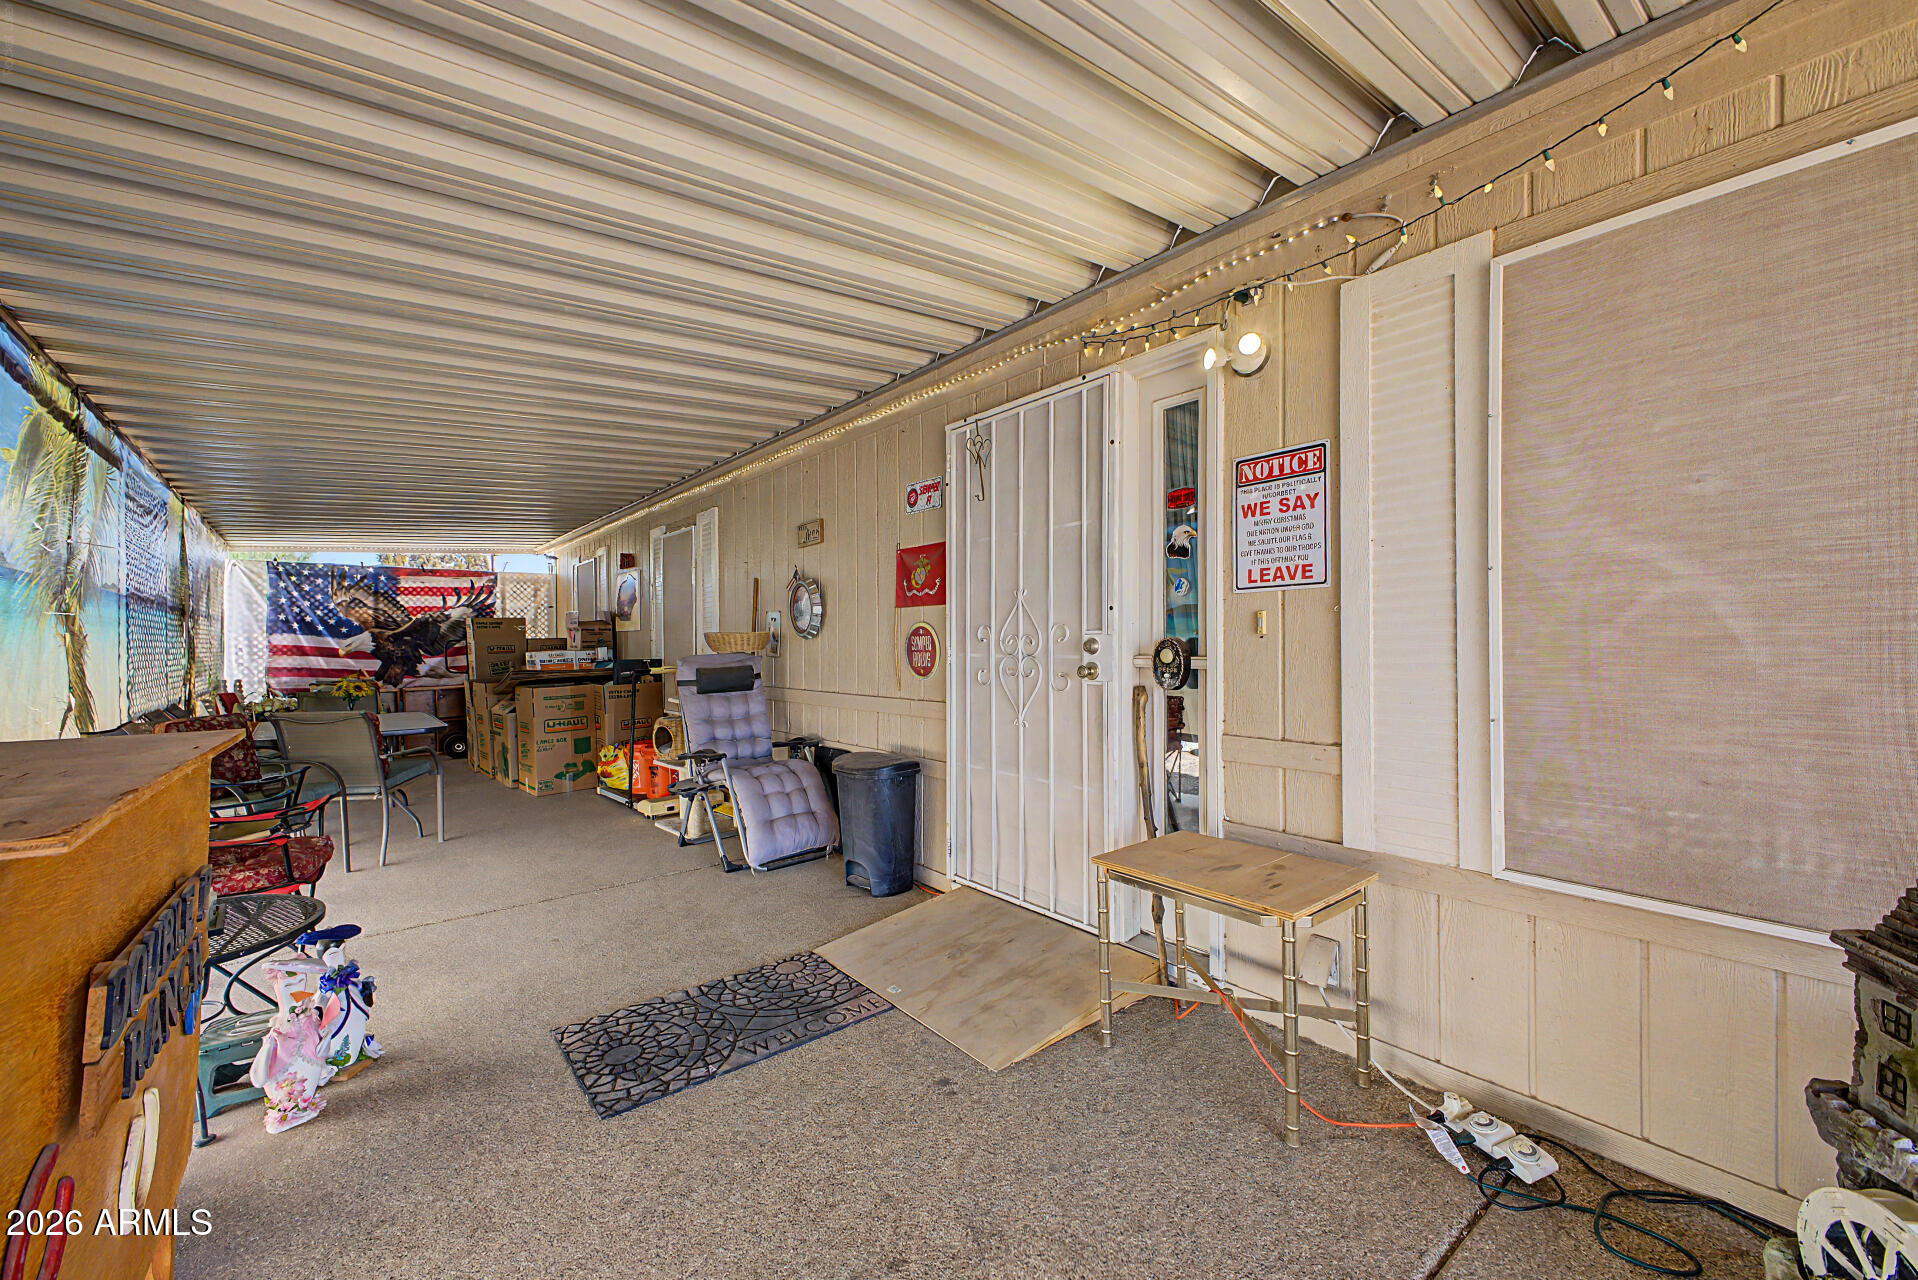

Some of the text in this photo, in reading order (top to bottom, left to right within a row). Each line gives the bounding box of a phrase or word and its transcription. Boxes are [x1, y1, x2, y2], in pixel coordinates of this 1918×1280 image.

[1241, 450, 1320, 482] NOTICE
[1254, 485, 1273, 493] PLACE
[1281, 476, 1321, 488] POLITICALLY
[1241, 492, 1320, 519] WE SAY
[1253, 513, 1307, 527] MERRY CHRISTMAS
[1246, 522, 1315, 538] ONE NATION UNDER GOD
[1279, 535, 1291, 543] OUR
[1291, 533, 1307, 541] FLAG
[1253, 547, 1275, 556] THANKS
[1284, 544, 1298, 552] OUR
[1298, 541, 1322, 551] TROOPS
[1257, 557, 1270, 566] THIS
[1247, 563, 1314, 584] LEAVE
[546, 718, 585, 729] U-HAUL
[100, 883, 196, 1050] DOUBLE
[738, 997, 886, 1056] WELCOME
